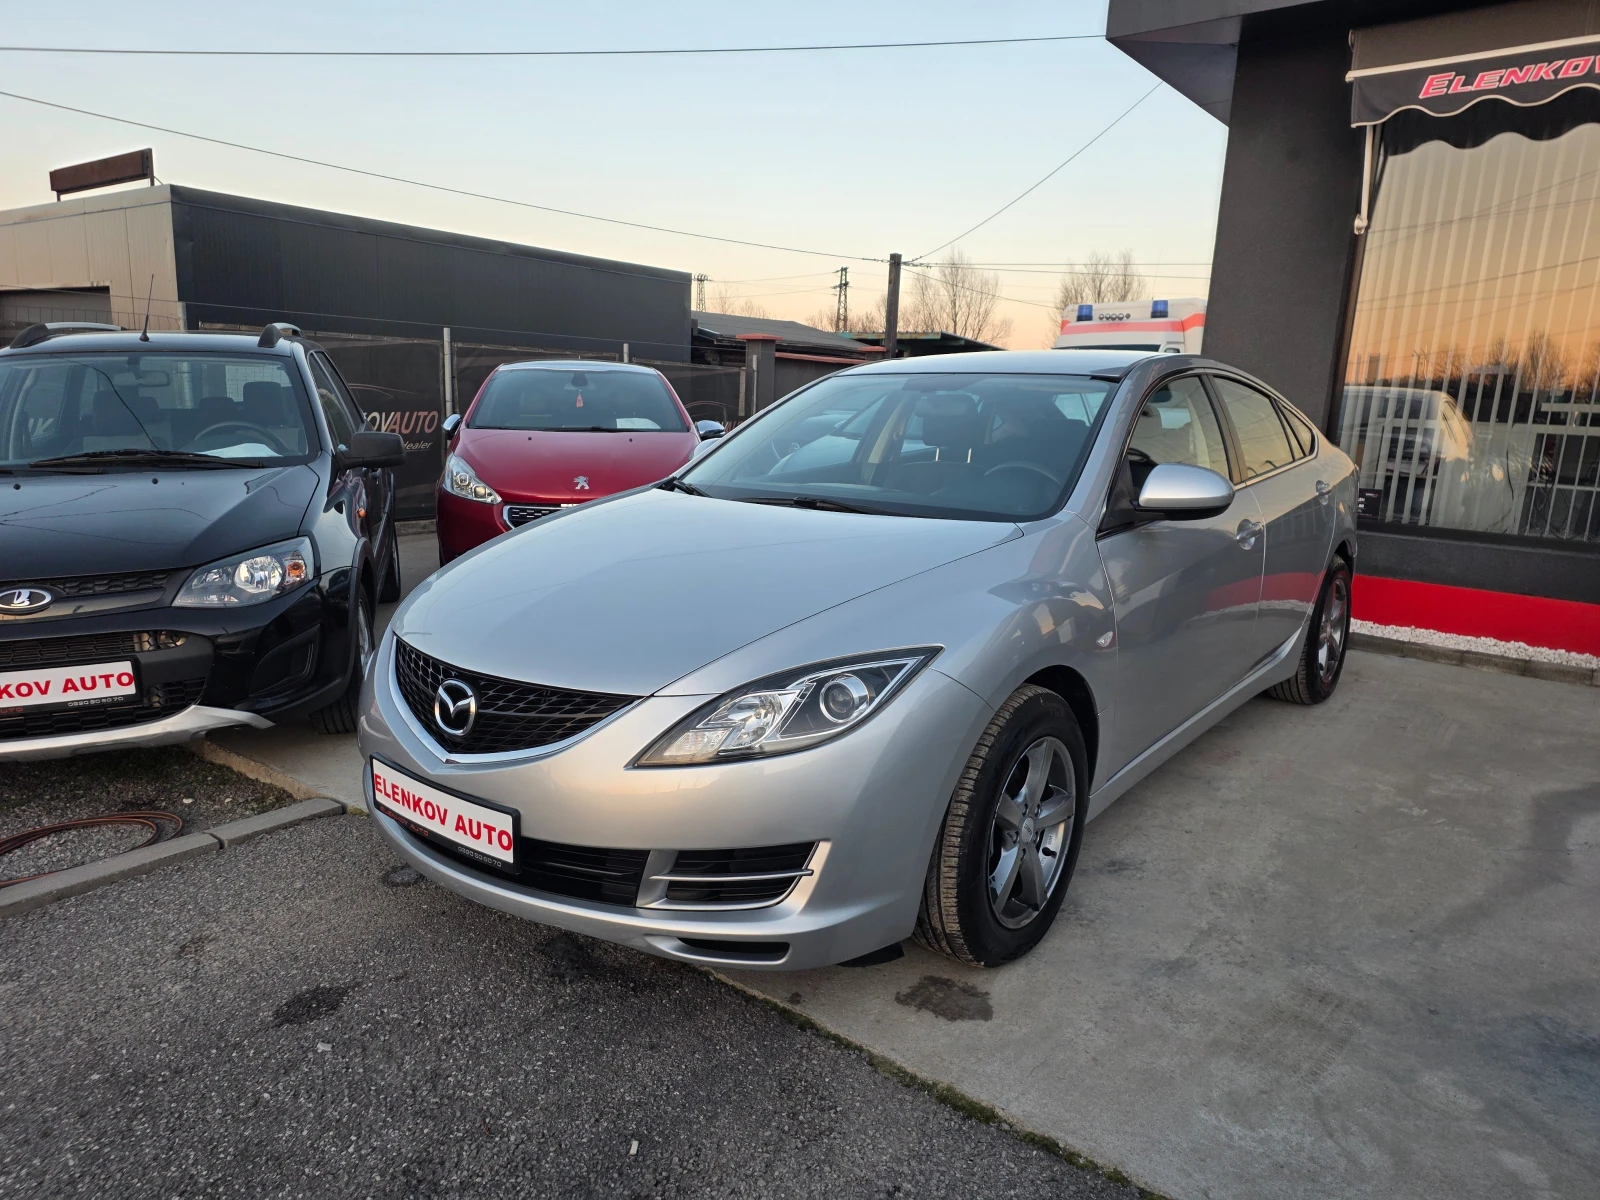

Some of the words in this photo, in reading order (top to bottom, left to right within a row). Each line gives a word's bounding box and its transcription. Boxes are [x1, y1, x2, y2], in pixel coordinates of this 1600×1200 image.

[1419, 55, 1600, 99] ELENKO
[62, 672, 134, 693] AUTO
[374, 773, 448, 826] ELENKOV
[454, 813, 513, 851] AUTO
